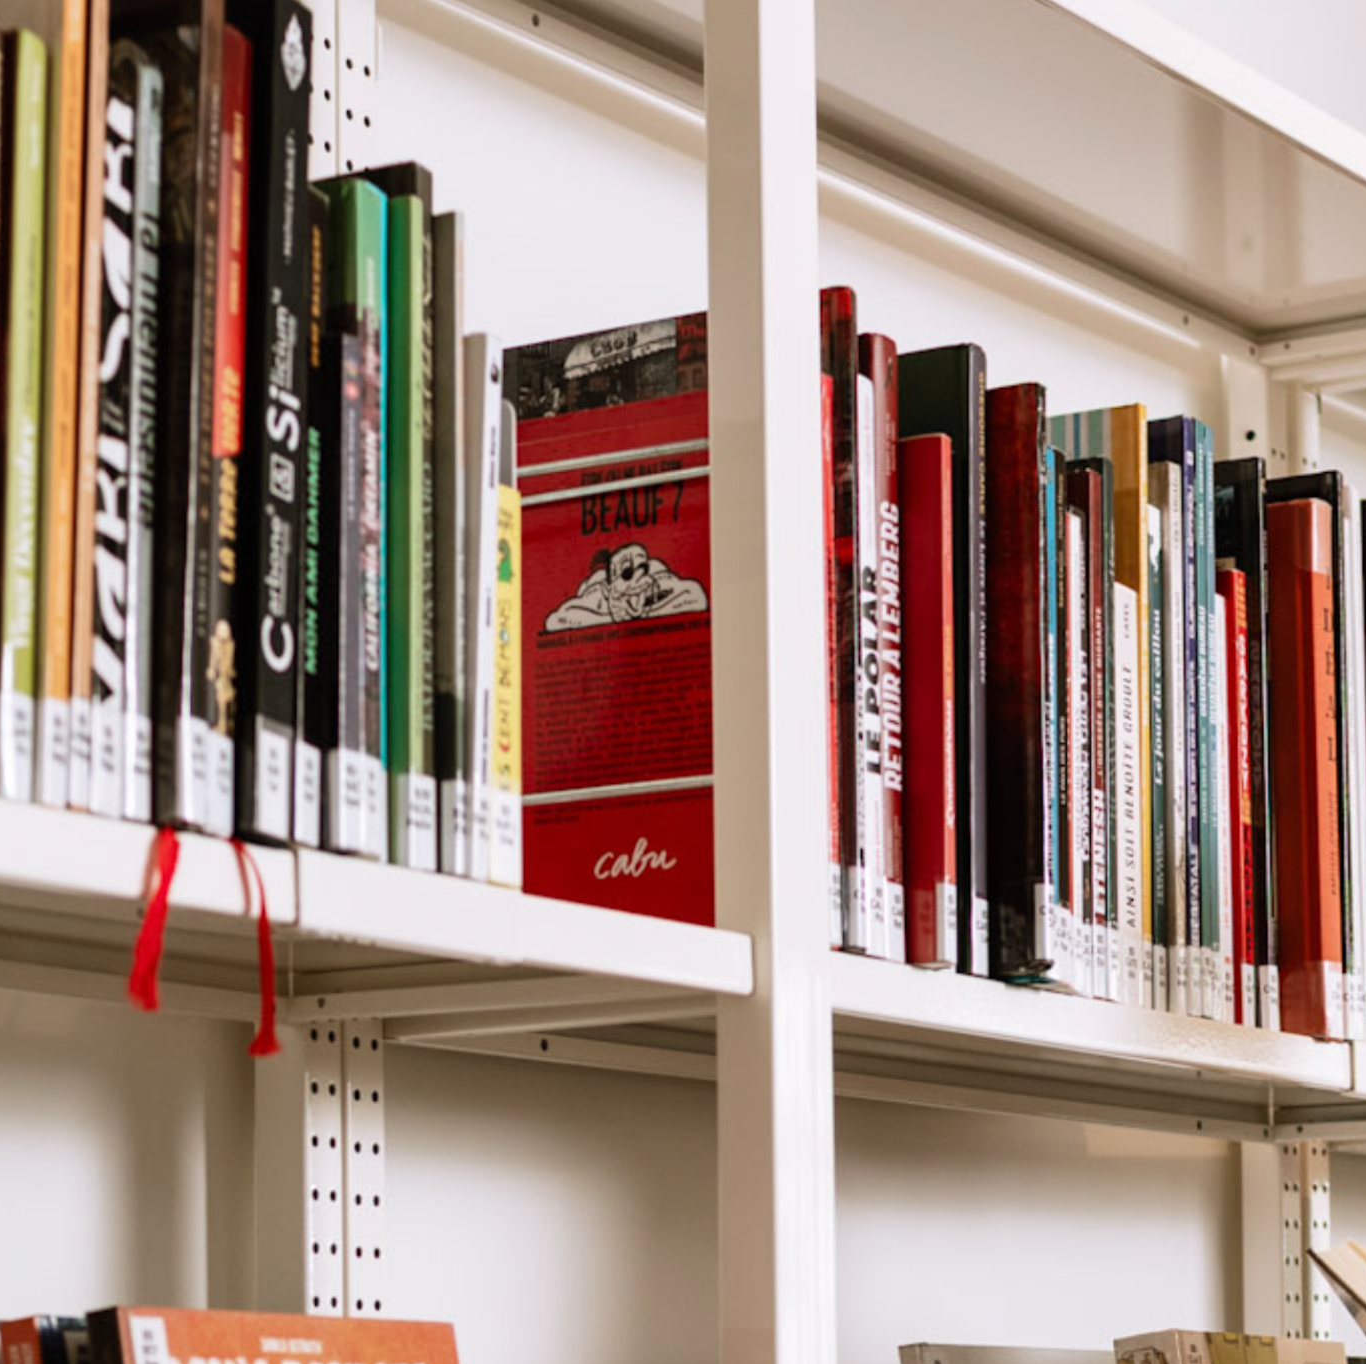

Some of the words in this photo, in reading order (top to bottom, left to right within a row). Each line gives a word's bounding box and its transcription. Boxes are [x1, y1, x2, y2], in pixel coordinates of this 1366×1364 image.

[305, 548, 320, 605] AMI
[880, 502, 901, 644] LEMBERG
[304, 608, 319, 676] MON
[860, 566, 881, 716] POLAR
[1151, 682, 1163, 709] du
[864, 730, 882, 775] LE
[882, 671, 903, 791] RETOUR
[1152, 712, 1165, 759] jour
[1153, 761, 1164, 786] Le
[1124, 829, 1135, 869] SOIT
[1125, 875, 1136, 928] AINSI
